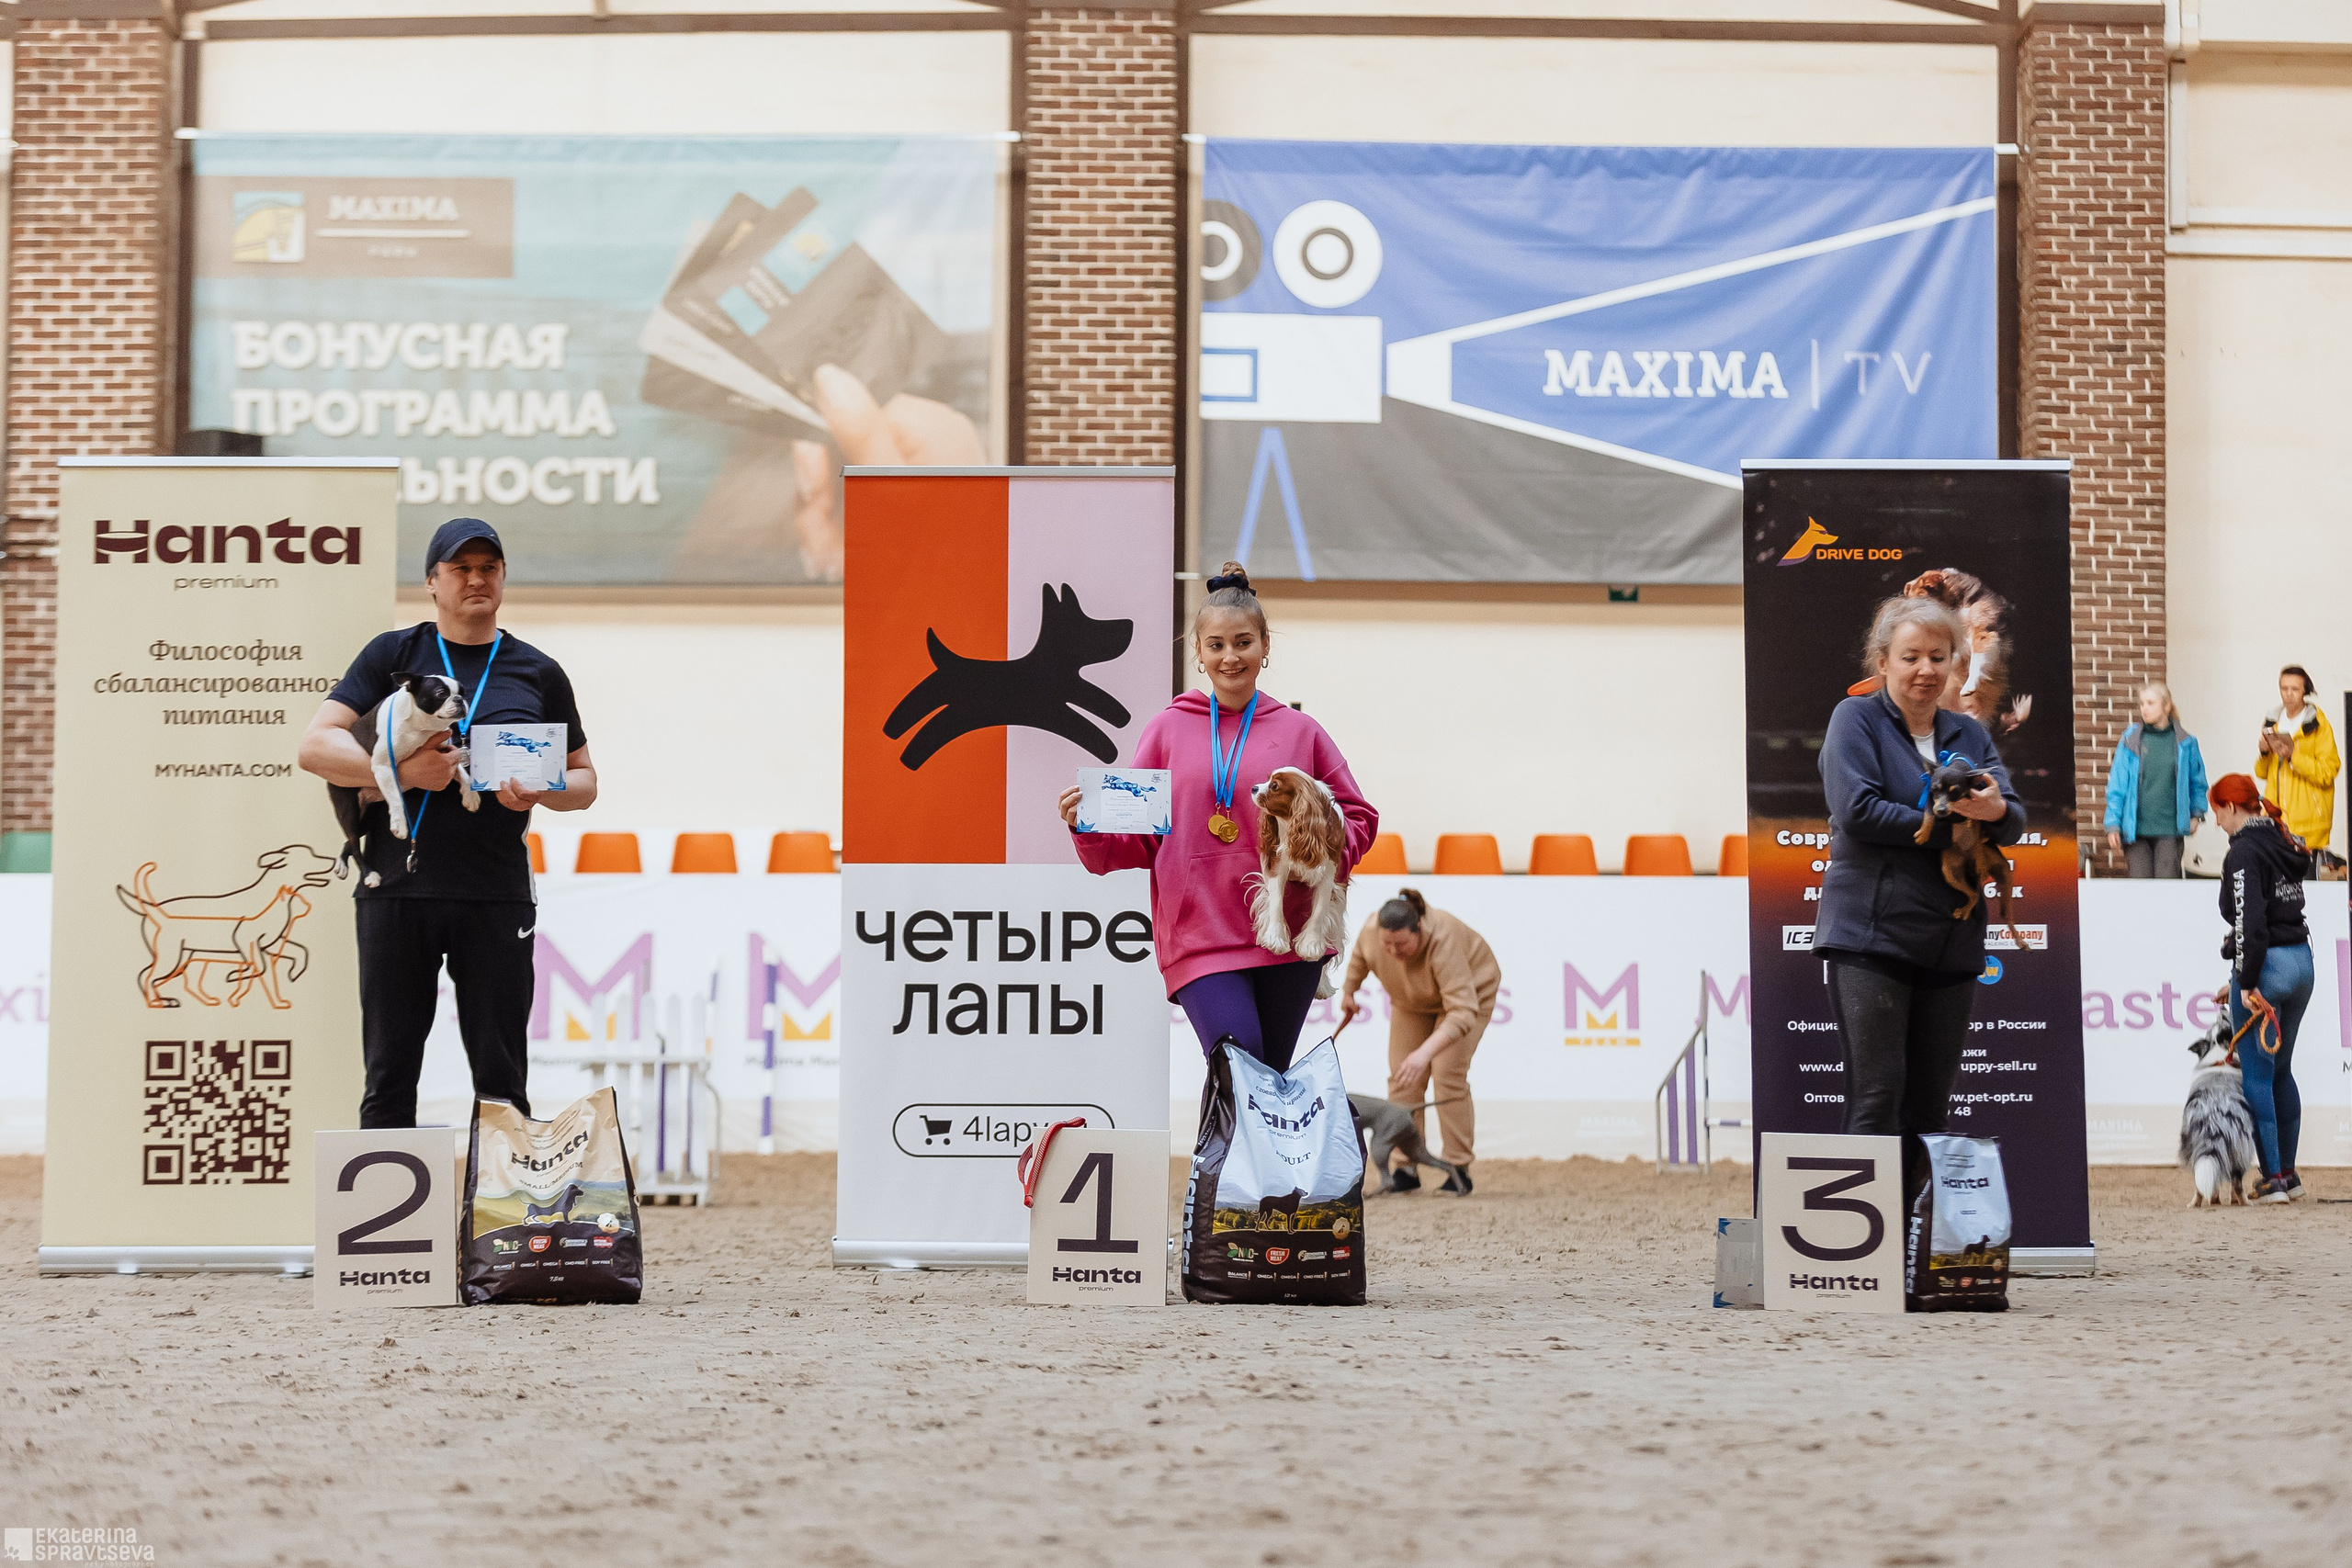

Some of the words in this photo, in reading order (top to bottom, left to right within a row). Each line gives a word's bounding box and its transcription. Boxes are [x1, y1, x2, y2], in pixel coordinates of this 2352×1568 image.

[232, 321, 568, 369] БОНУСНАЯ
[1543, 349, 1789, 399] MAXIMA
[1843, 351, 1932, 396] TV
[232, 389, 616, 438] ПРОГРАММА
[399, 457, 660, 505] ЬНОСТИ
[94, 517, 363, 565] Hanta
[1816, 548, 1864, 560] DRIVE
[1868, 548, 1903, 560] DOG
[174, 575, 279, 591] premium
[149, 639, 304, 666] Философия
[94, 672, 341, 699] сбалансированног
[163, 708, 288, 726] питания
[154, 763, 293, 778] MYHANTA.COM
[855, 909, 1154, 963] четыре
[892, 982, 1103, 1036] лапы
[1787, 1020, 1838, 1032] Официа
[1997, 1020, 2047, 1030] России
[1799, 1061, 1844, 1072] www.d
[1961, 1060, 2037, 1073] uppy-sell.ru
[1804, 1092, 1845, 1102] Оптов
[1949, 1092, 2033, 1104] w.pet-opt.ru
[1248, 1093, 1325, 1132] Hanta
[1954, 1106, 1972, 1116] 48
[1269, 1129, 1306, 1140] premium
[511, 1130, 589, 1172] Hanta
[1940, 1176, 1989, 1189] Hanta
[337, 1151, 433, 1256] 2
[1057, 1152, 1138, 1253] 1
[1182, 1154, 1205, 1275] Hanta
[1781, 1156, 1883, 1261] 3
[1906, 1216, 1923, 1293] Hanta
[340, 1268, 431, 1287] Hanta
[1052, 1267, 1141, 1284] Hanta
[1790, 1273, 1879, 1291] Hanta
